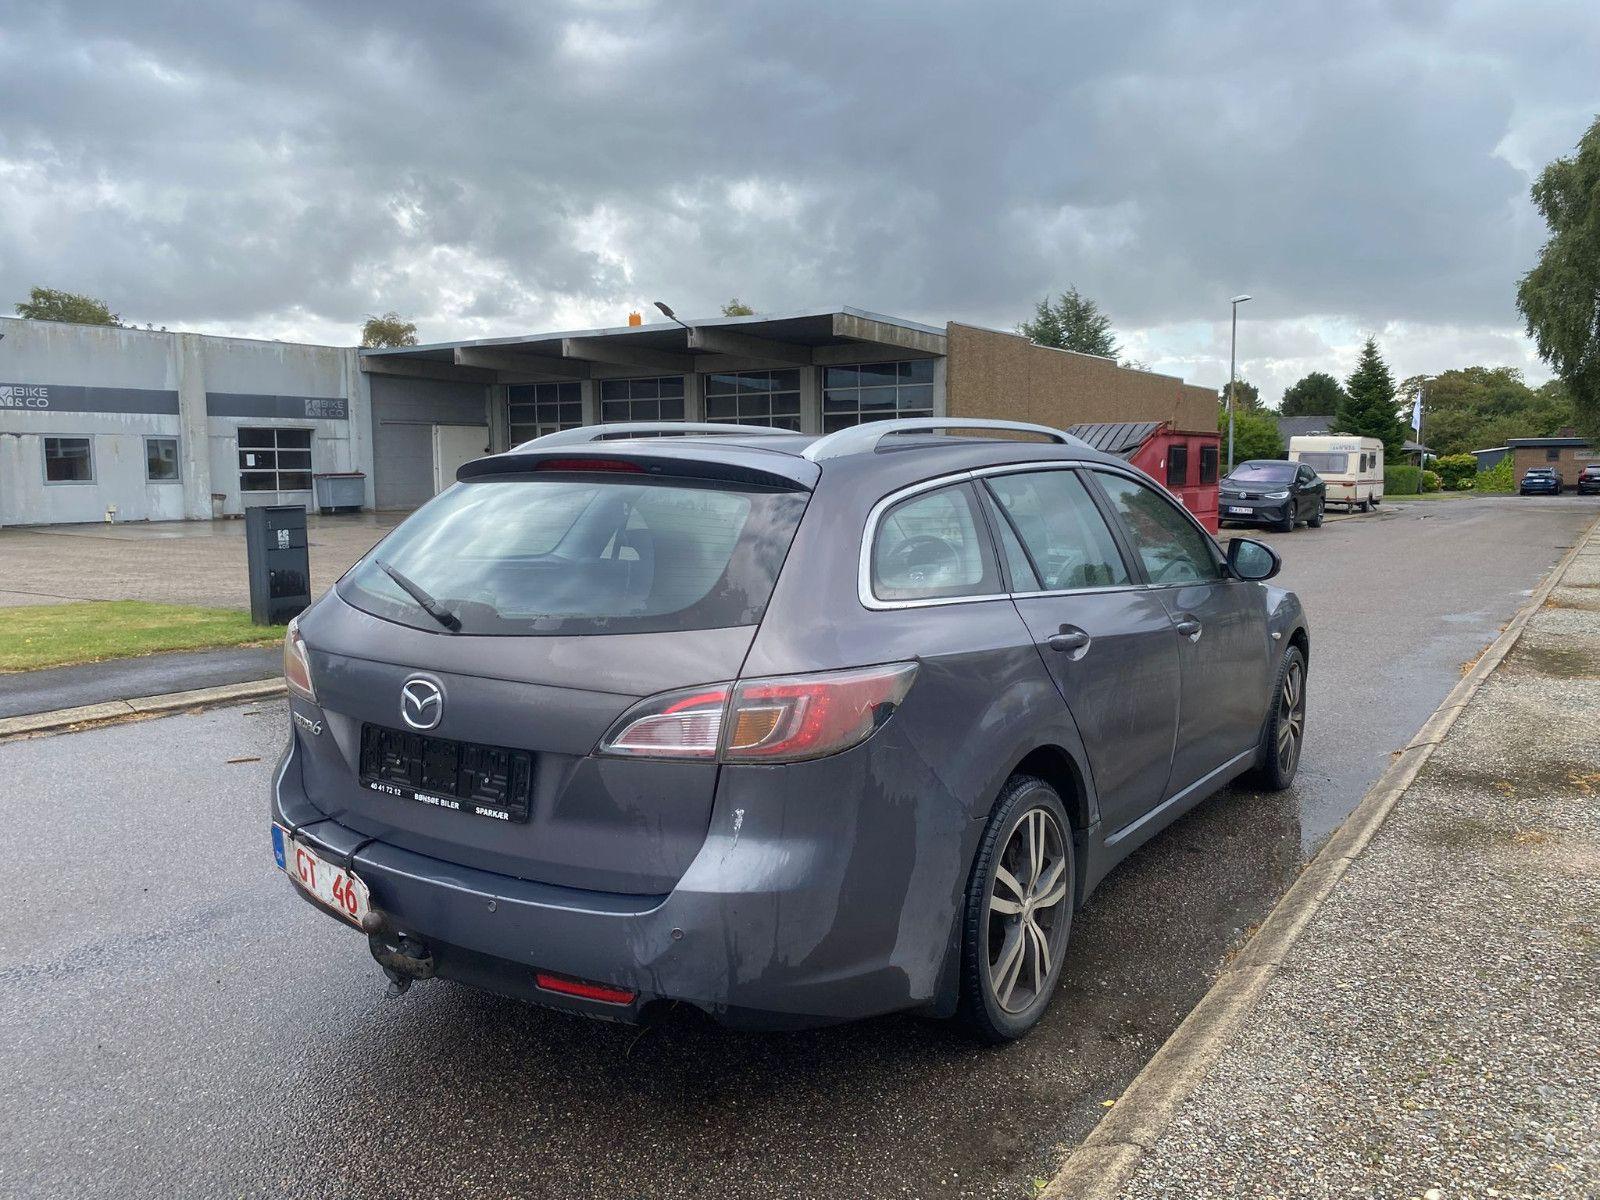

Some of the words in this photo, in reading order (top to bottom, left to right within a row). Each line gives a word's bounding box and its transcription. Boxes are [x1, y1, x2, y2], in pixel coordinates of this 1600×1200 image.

[14, 387, 48, 397] BIKE
[15, 398, 22, 406] &
[26, 398, 49, 407] CO
[321, 400, 345, 409] BIKE
[378, 784, 385, 792] 41
[386, 786, 393, 794] 72
[394, 788, 402, 796] 12
[440, 799, 460, 809] BILER
[475, 807, 509, 820] SPARKÆR
[297, 848, 316, 889] GT
[333, 875, 358, 914] 46
